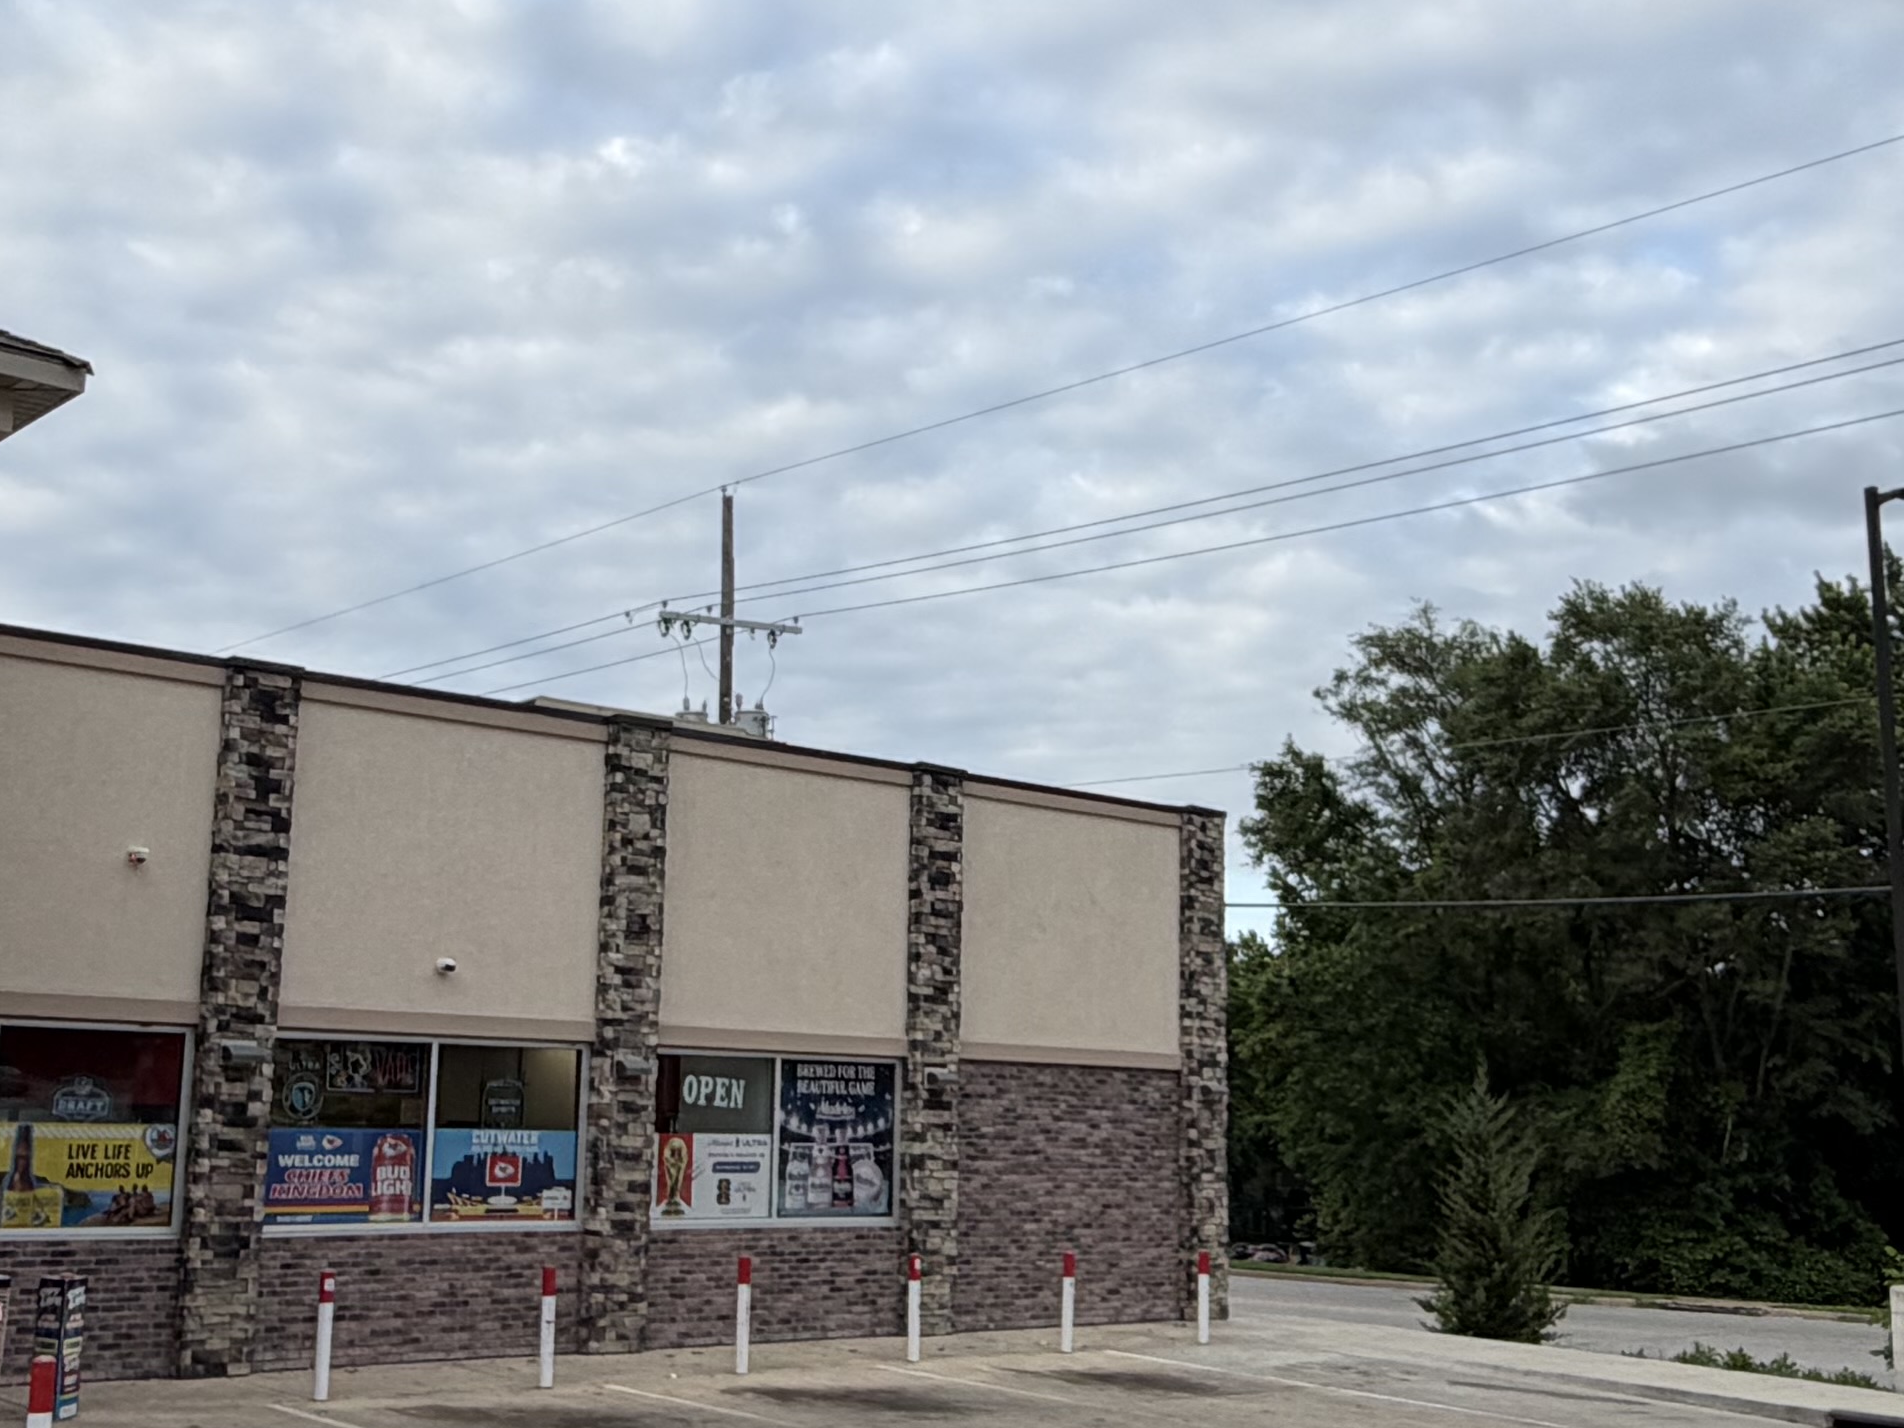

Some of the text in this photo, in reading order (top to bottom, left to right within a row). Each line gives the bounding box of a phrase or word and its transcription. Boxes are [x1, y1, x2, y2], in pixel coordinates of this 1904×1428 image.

[797, 1063, 876, 1081] BREWED FOR THE
[682, 1074, 746, 1109] OPEN
[796, 1079, 876, 1097] BEAUTIFUL GAME
[471, 1130, 539, 1145] CUTWATER
[68, 1143, 132, 1161] LIVE LIFE
[277, 1153, 361, 1168] WELCOME
[65, 1162, 154, 1180] ANCHORS UP
[284, 1168, 351, 1184] CHIEFS
[376, 1165, 411, 1180] BUD
[269, 1182, 364, 1200] KINGDOM
[371, 1179, 413, 1197] LIGHT
